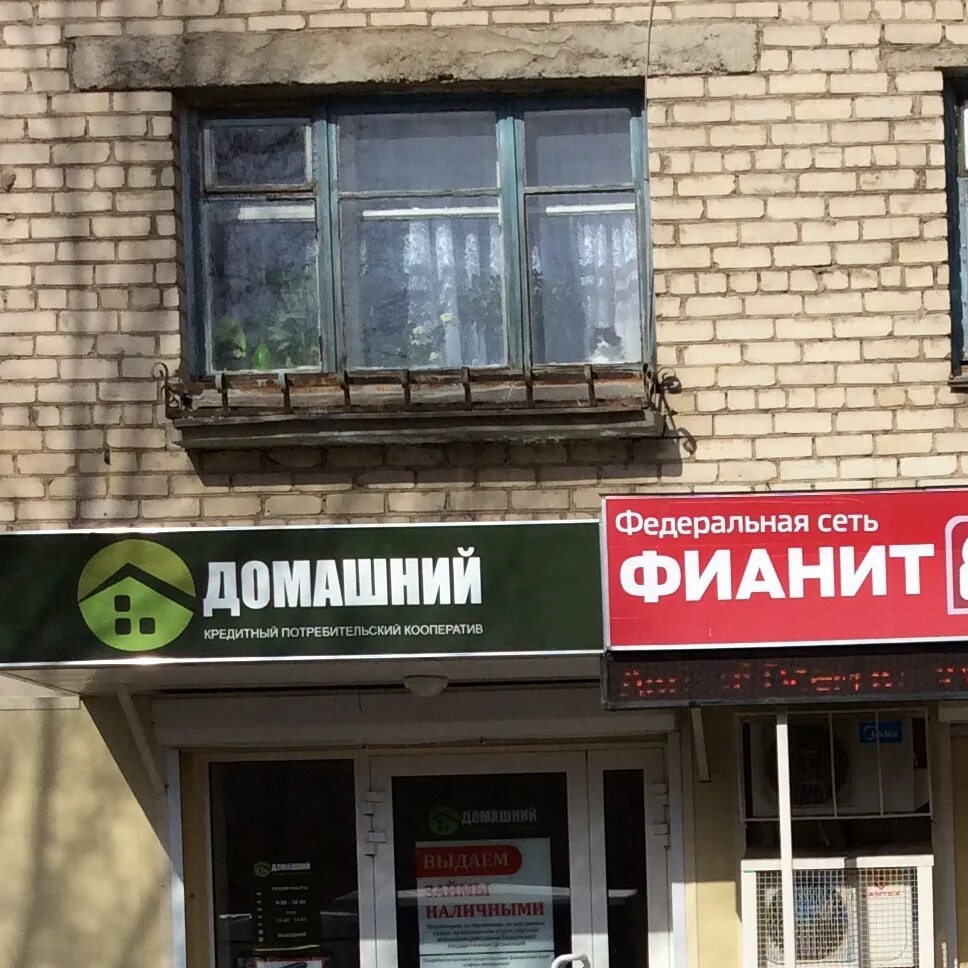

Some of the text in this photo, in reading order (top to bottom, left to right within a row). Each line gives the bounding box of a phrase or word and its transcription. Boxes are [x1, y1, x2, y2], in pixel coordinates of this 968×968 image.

[615, 510, 879, 539] Федеральная сеть
[203, 547, 483, 617] ДОМАШНИЙ
[620, 543, 935, 603] ФИАНИТ
[204, 623, 484, 640] КРЕДИТНЫЙ ПОТРЕБИТЕЛЬСКИЙ КООПЕРАТИВ
[461, 806, 537, 826] ДОМАШНИЙ
[423, 852, 509, 872] ВЫДАЕМ
[424, 880, 491, 898] ЗАЙМЫ
[426, 902, 544, 919] НАЛИЧНЫМИ
